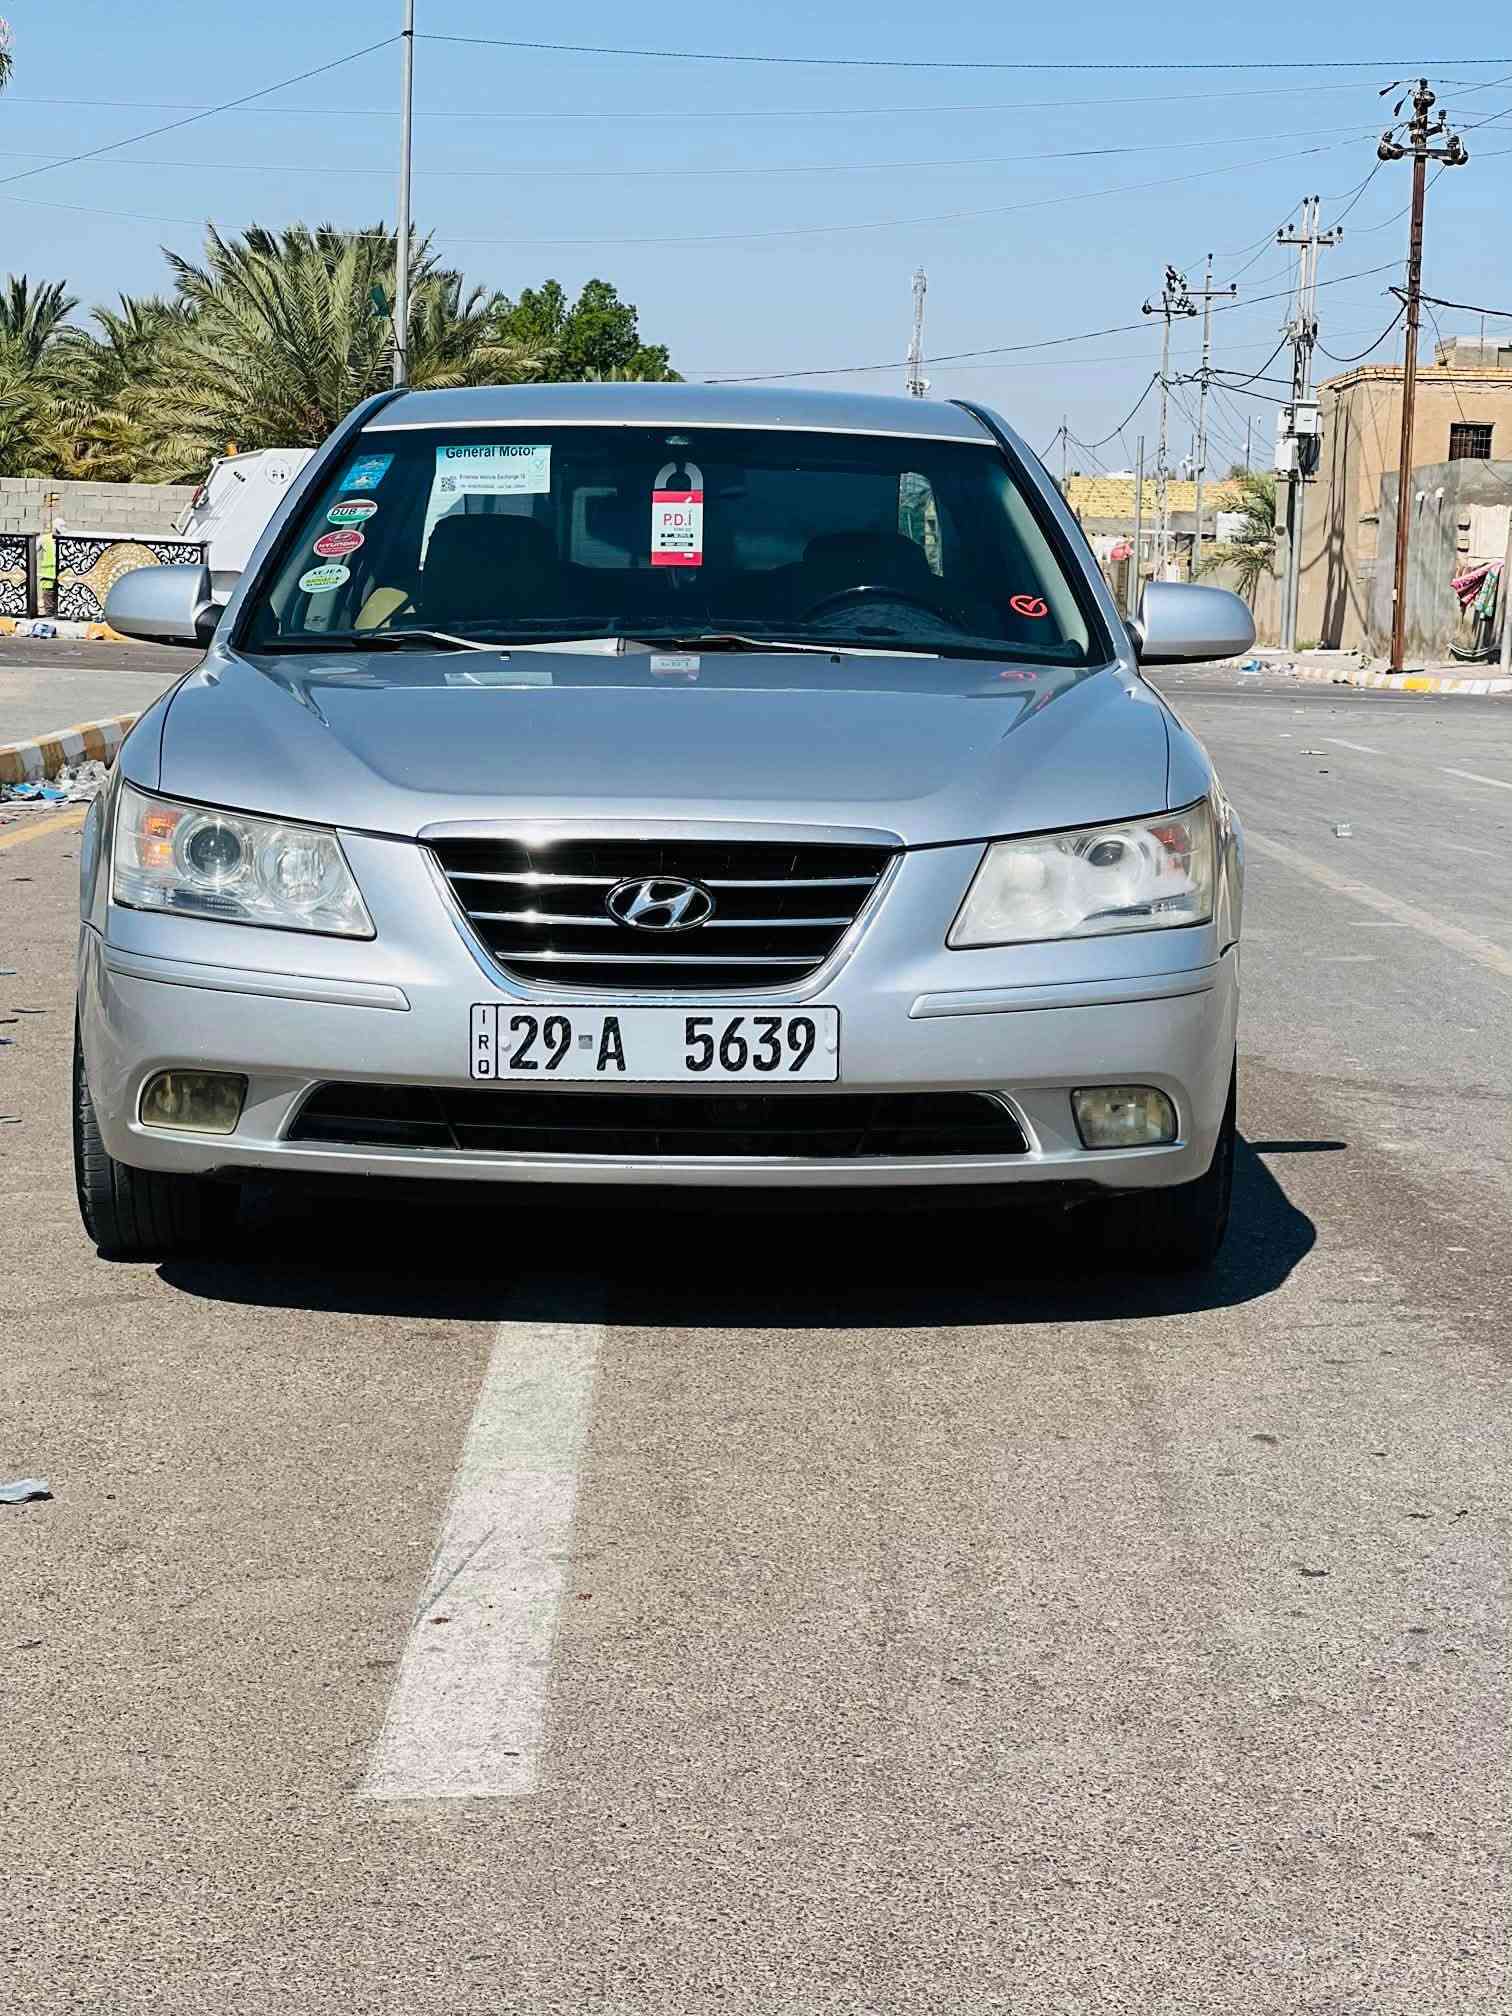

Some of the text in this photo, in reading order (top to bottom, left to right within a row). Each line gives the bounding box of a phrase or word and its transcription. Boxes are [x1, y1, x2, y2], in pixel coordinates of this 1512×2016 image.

[446, 446, 536, 459] General Motor
[509, 1015, 817, 1072] 29 A 5639
